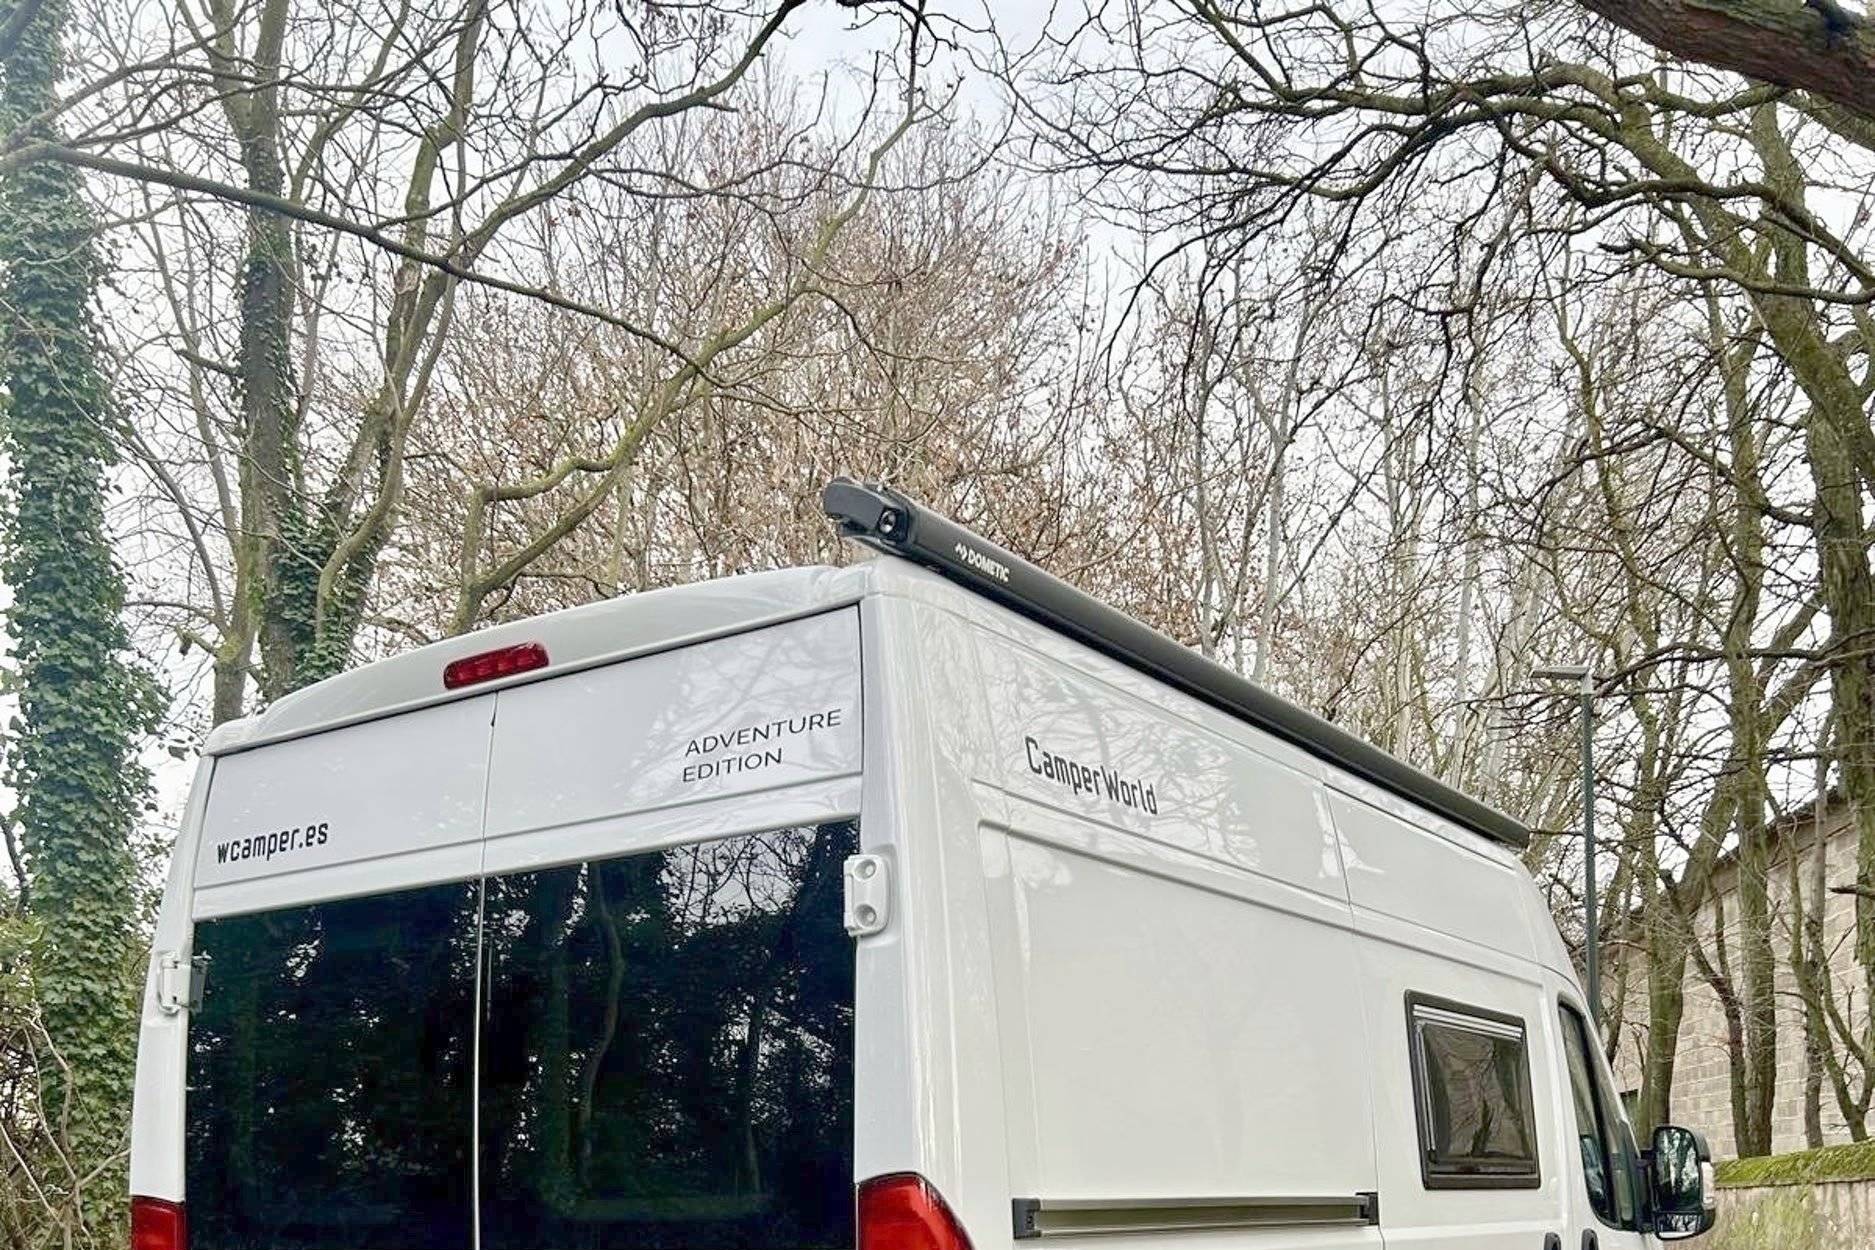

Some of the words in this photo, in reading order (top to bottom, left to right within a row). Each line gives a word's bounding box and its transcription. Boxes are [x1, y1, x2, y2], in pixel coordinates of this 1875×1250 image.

[968, 548, 1010, 582] DOMETIC
[685, 708, 841, 757] ADVENTURE
[682, 748, 782, 783] EDITION
[1024, 735, 1158, 815] CamperWorld
[217, 822, 329, 864] wcamper.es
